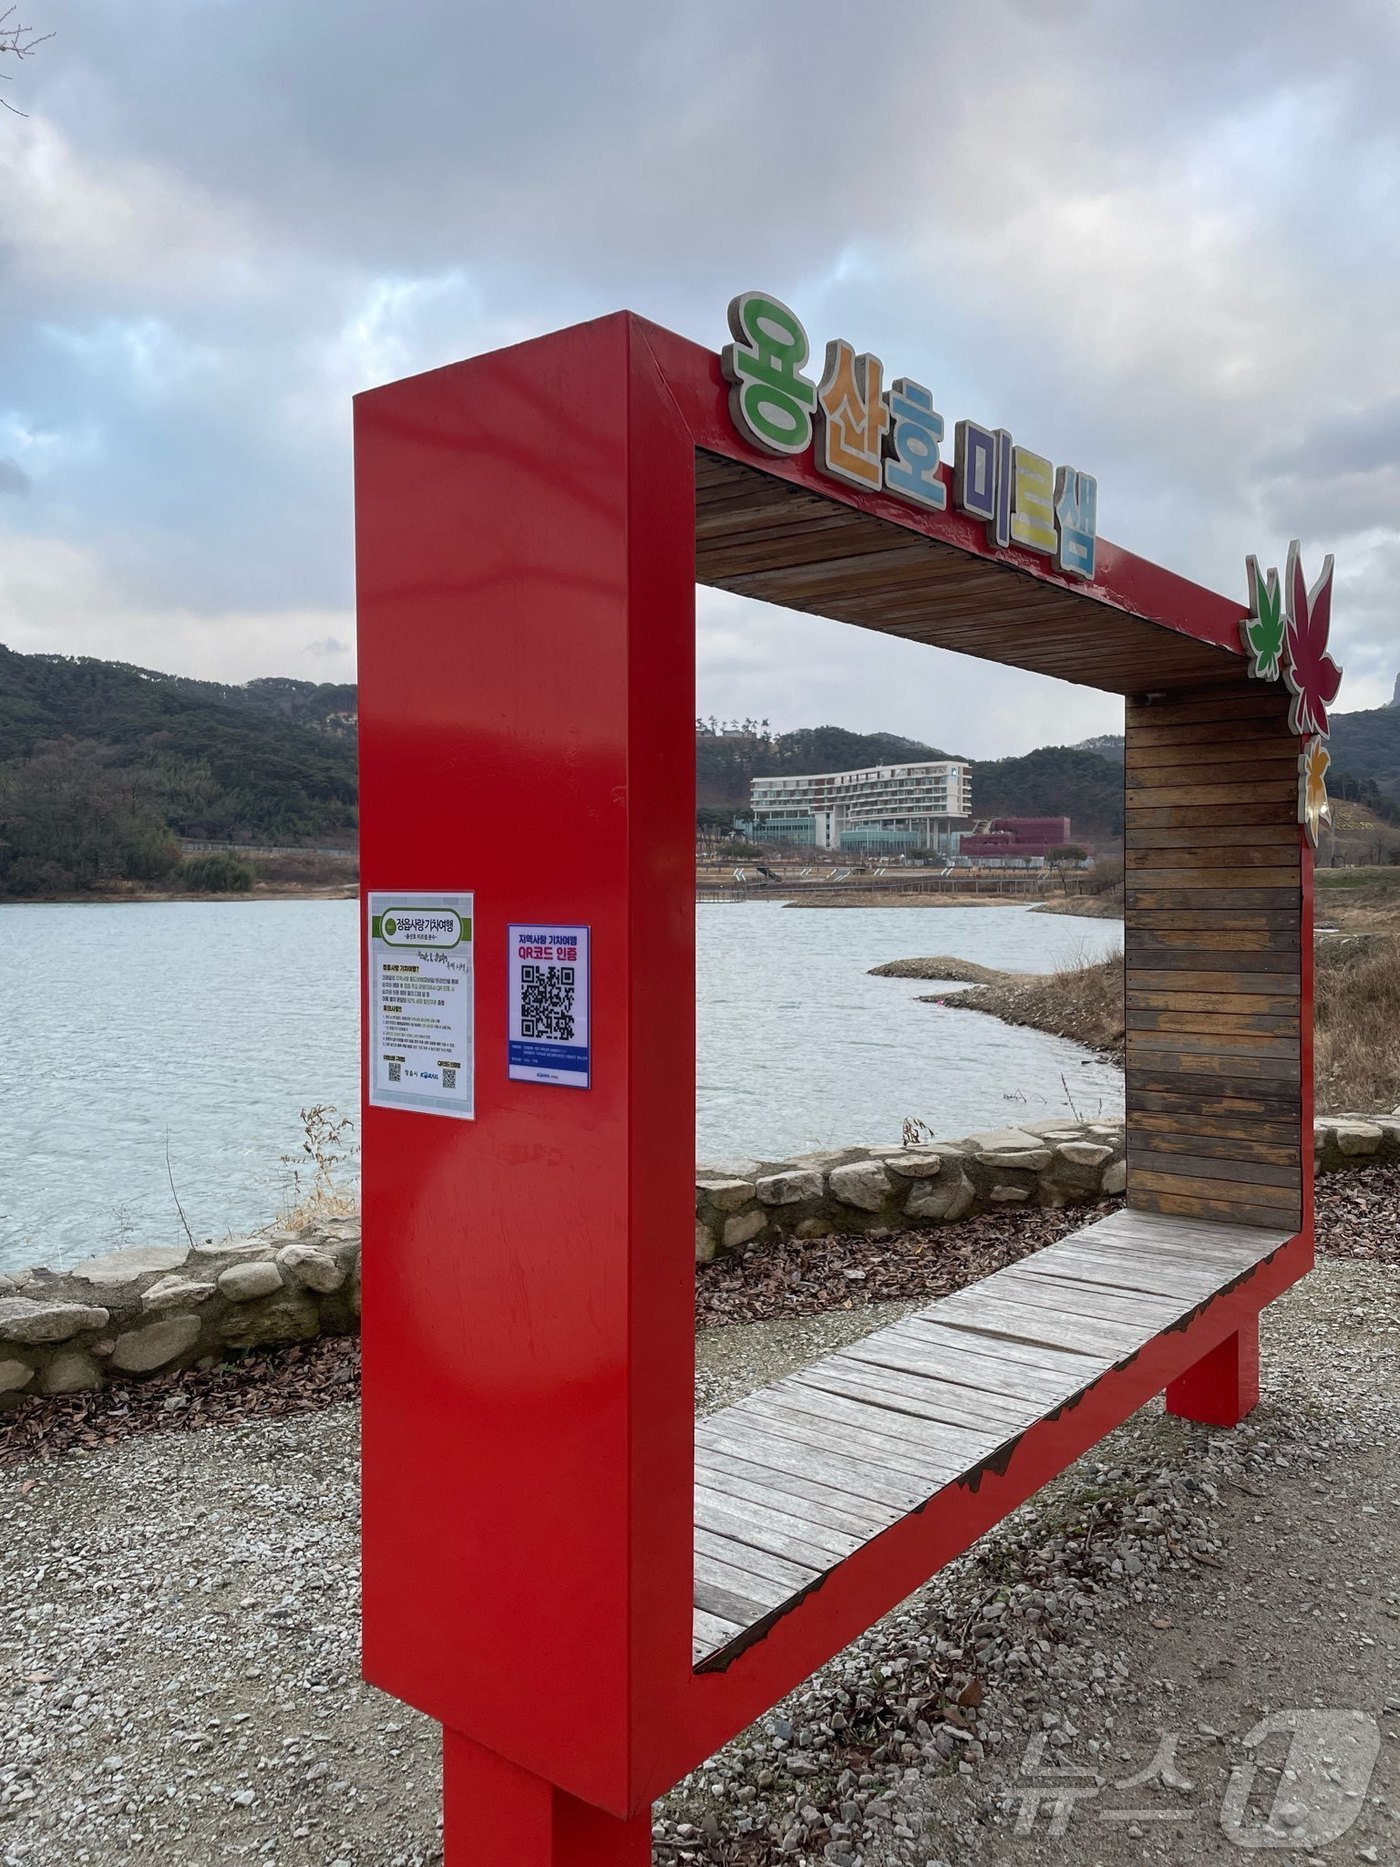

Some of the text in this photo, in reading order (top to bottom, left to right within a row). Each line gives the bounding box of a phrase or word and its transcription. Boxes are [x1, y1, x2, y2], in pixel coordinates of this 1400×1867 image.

[722, 291, 1097, 580] 용산호 미르샘
[396, 918, 454, 933] 정읍사랑 기차여행
[518, 934, 578, 946] 지역사랑 기차여행
[518, 946, 577, 961] QR코드 인증
